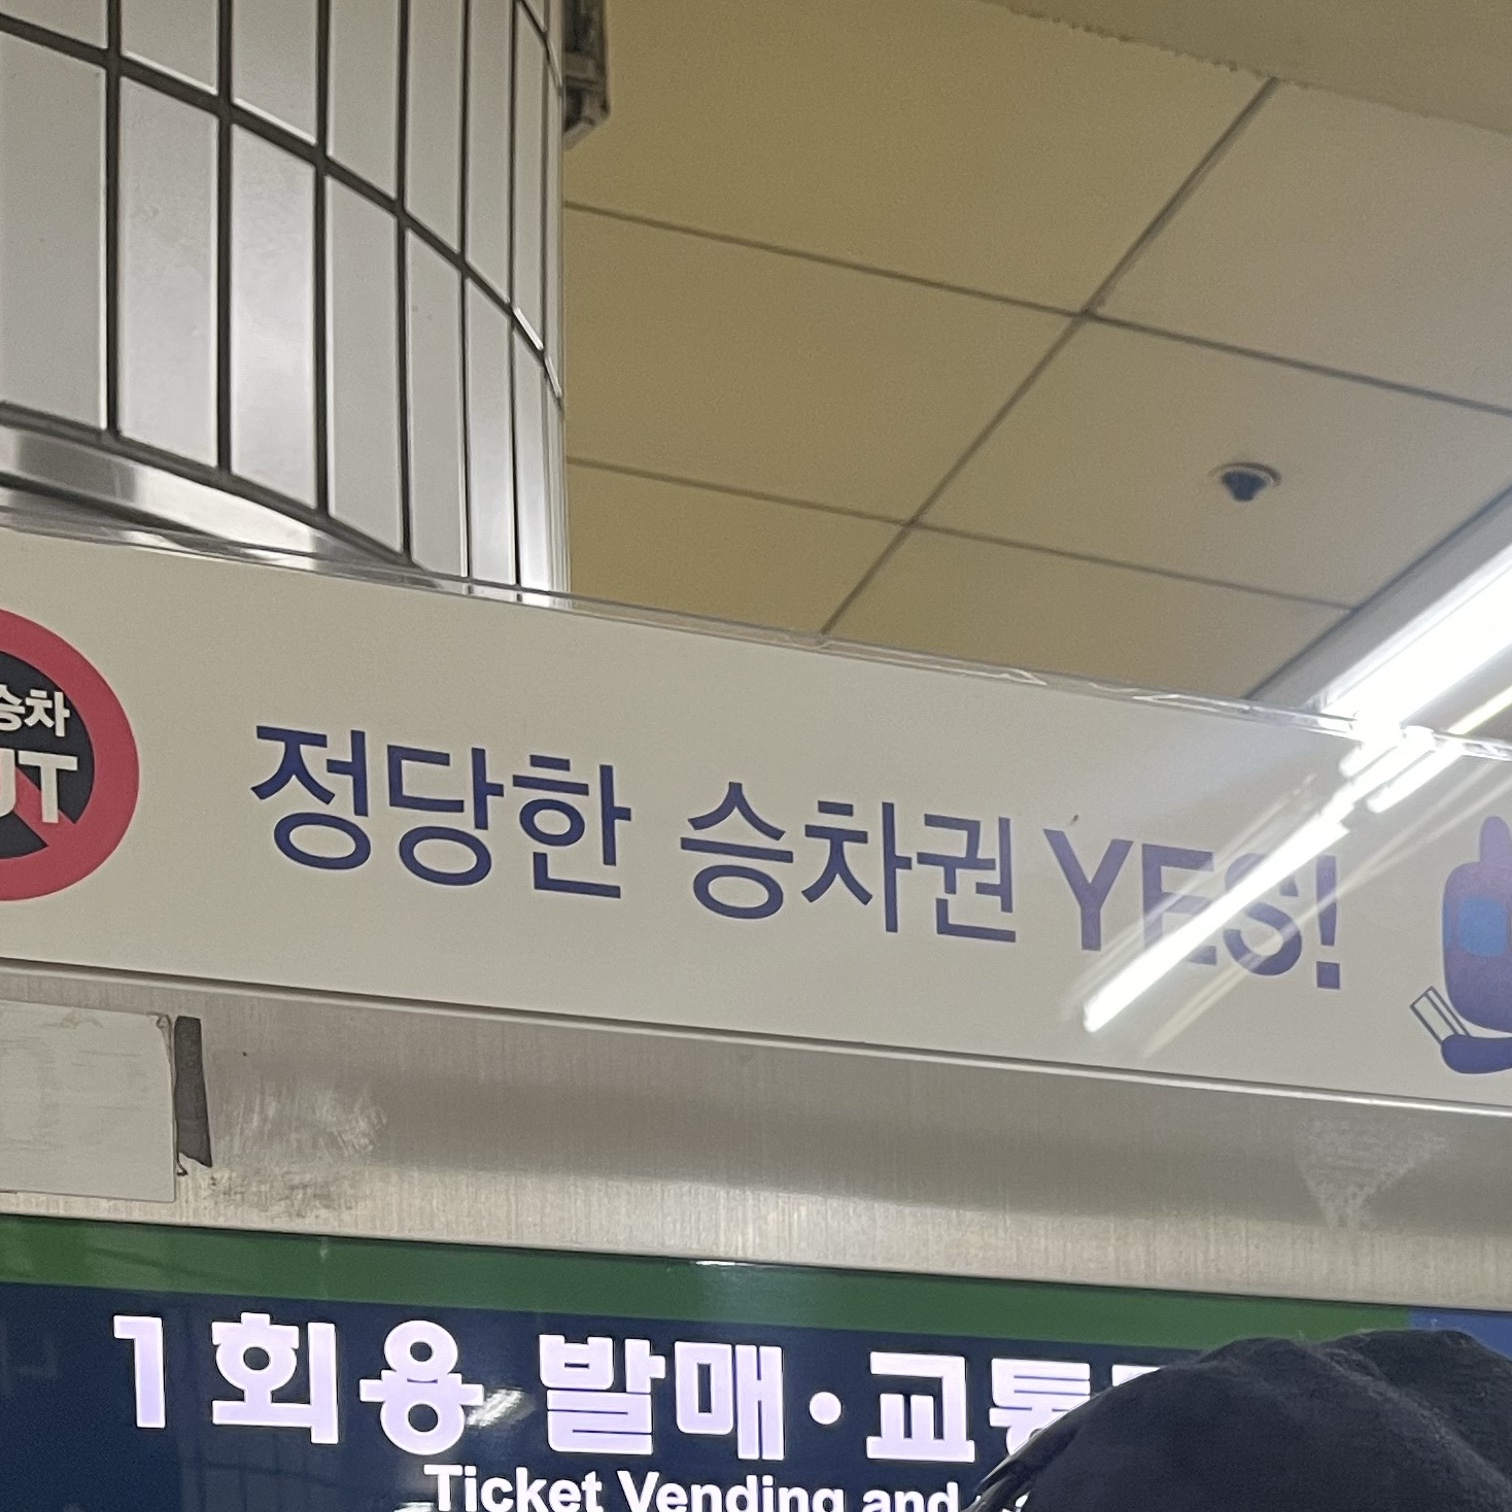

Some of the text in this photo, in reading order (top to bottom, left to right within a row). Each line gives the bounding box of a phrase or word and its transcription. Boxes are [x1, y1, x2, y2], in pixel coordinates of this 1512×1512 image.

[252, 726, 1342, 990] 정당한 승차권 YES!
[113, 1312, 484, 1456] 1회용
